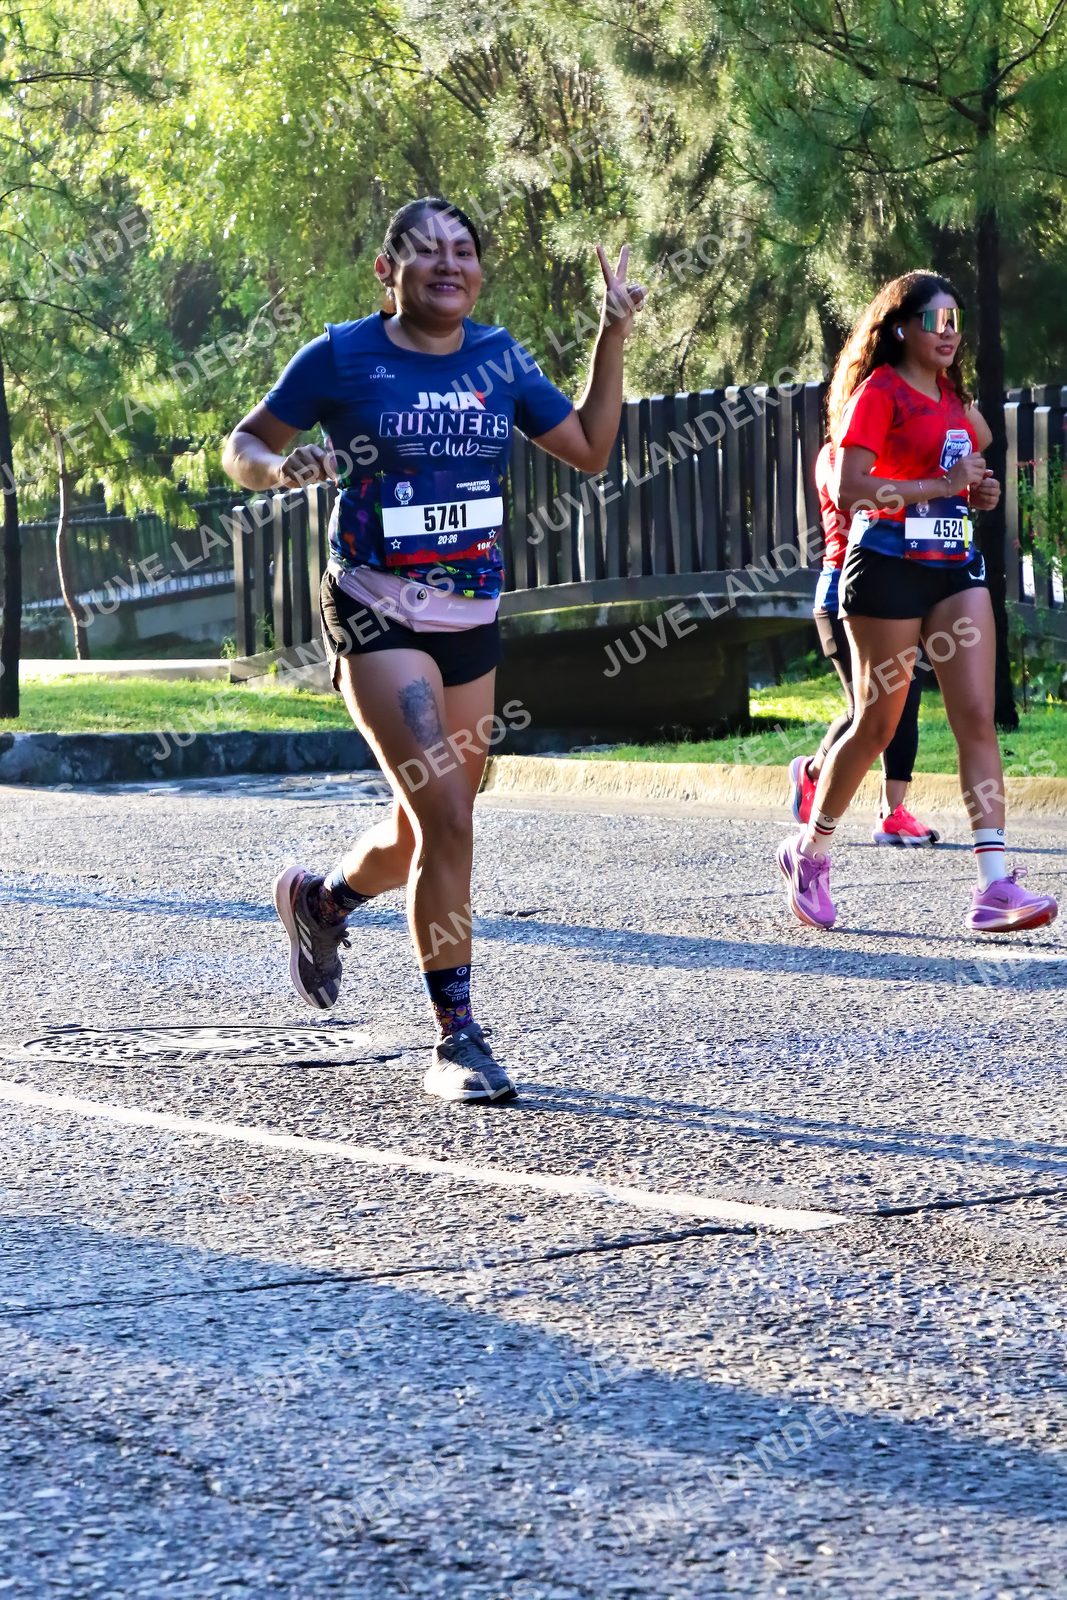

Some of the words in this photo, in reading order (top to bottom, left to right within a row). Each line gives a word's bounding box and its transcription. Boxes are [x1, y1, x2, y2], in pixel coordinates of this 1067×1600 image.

[412, 391, 486, 411] JMA
[379, 411, 509, 439] RUNNERS
[429, 437, 480, 456] club
[423, 503, 467, 532] 5741
[933, 519, 964, 538] 4524
